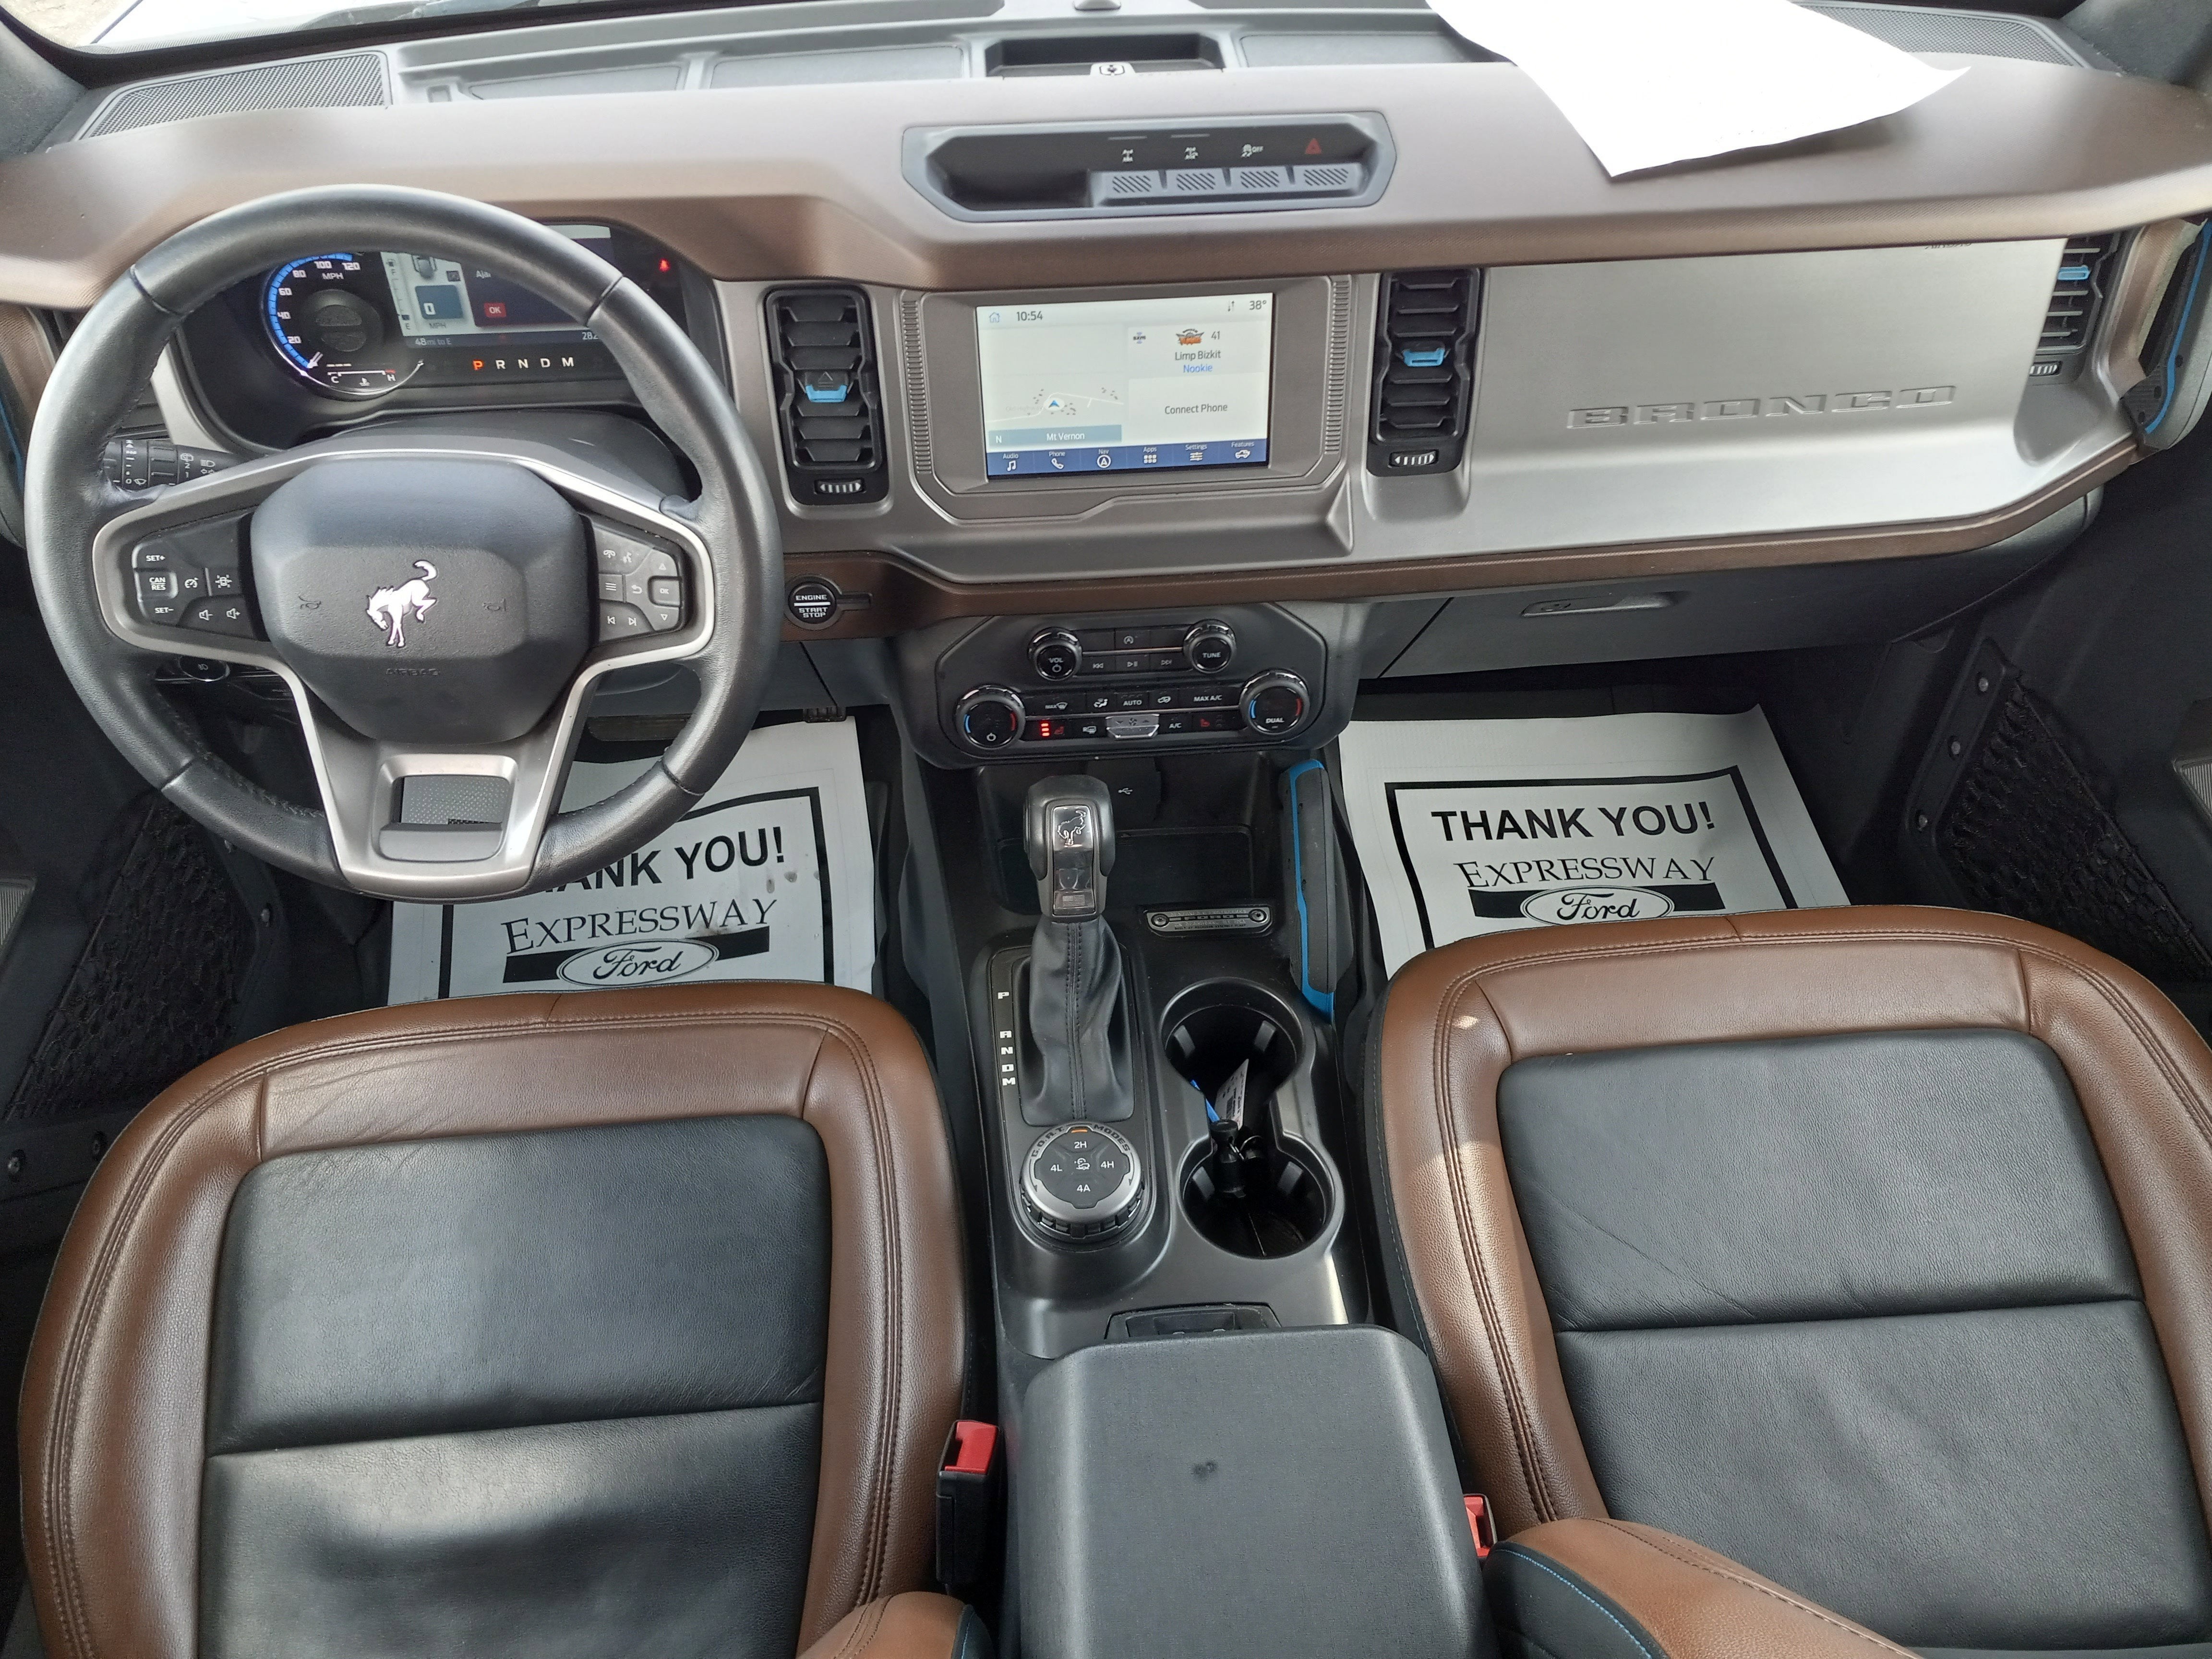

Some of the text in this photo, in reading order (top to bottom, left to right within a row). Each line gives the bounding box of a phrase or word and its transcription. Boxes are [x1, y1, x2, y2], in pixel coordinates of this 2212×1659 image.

[314, 261, 332, 269] 100
[342, 262, 361, 270] 120
[292, 270, 307, 278] 80
[278, 288, 292, 296] 60
[423, 302, 436, 315] 0
[489, 306, 502, 314] OK
[1249, 300, 1267, 311] 38°
[1016, 311, 1043, 321] 10:54
[288, 336, 302, 344] 20
[1211, 331, 1220, 340] 41
[1175, 350, 1221, 361] Limp Bizkit
[472, 357, 574, 371] P R N D M
[1183, 364, 1213, 373] Nookie
[1165, 403, 1228, 415] Connect Phone
[1566, 385, 1957, 429] BRONCO
[996, 435, 1002, 444] N
[1046, 432, 1085, 441] Mt Vernon
[1185, 443, 1207, 451] Settings
[1431, 801, 1716, 842] THANK YOU!
[674, 826, 784, 880] YOU!
[1453, 856, 1715, 888] EXPRESSWAY
[1556, 892, 1640, 921] Ford
[501, 898, 777, 954] EXPRESSWAY
[593, 946, 684, 980] Ford
[1001, 1046, 1013, 1055] N
[1002, 1064, 1014, 1072] D
[1002, 1077, 1016, 1086] M
[1093, 1124, 1130, 1152] MODES
